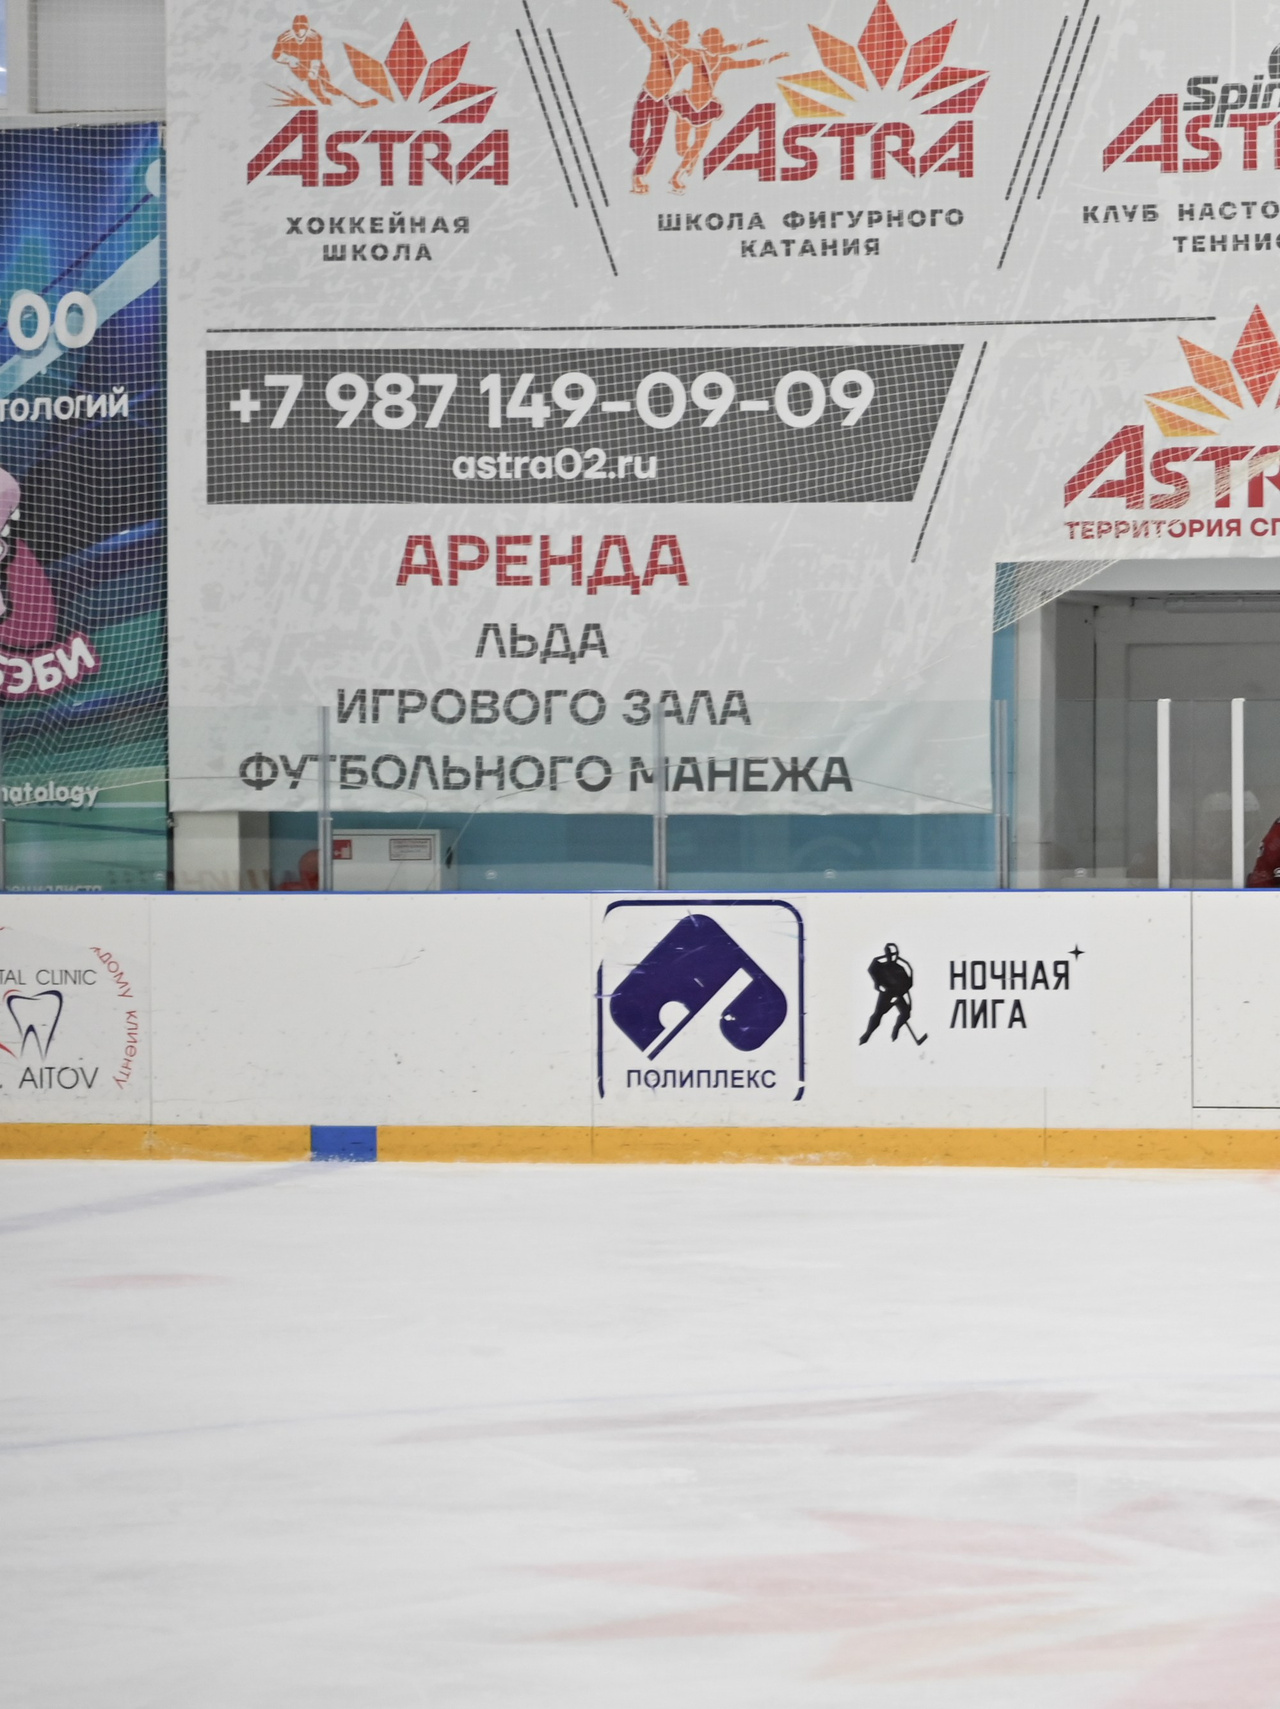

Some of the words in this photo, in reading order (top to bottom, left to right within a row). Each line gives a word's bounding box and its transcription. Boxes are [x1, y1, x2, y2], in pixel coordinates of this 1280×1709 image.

[247, 109, 509, 187] ASTRA
[703, 102, 974, 182] ASTRA
[286, 211, 470, 235] ХОККЕЙНАЯ
[657, 211, 766, 232] ШКОЛА
[782, 208, 965, 231] ФИГУРНОГО
[1082, 203, 1160, 224] КЛУБ
[323, 243, 433, 261] ШКОЛА
[740, 237, 880, 258] КАТАНИЯ
[229, 373, 305, 430] +7
[324, 371, 458, 430] 987
[479, 369, 876, 430] 149-09-09
[451, 446, 658, 481] astra02.ru
[1063, 517, 1242, 540] ТЕРРИТОРИЯ
[395, 533, 690, 595] АРЕНДА
[475, 622, 610, 664] ЛЬДА
[0, 637, 96, 693] ЭБИ
[336, 688, 607, 726] ИГРОВОГО
[621, 688, 752, 726] ЗАЛА
[629, 755, 854, 793] МАНЕЖА
[36, 969, 97, 986] CLINIC
[949, 960, 1071, 991] НОЧНАЯ
[949, 999, 1028, 1030] ЛИГА
[18, 1066, 99, 1090] AITOV
[626, 1069, 777, 1090] ПОЛИПЛЕКС
